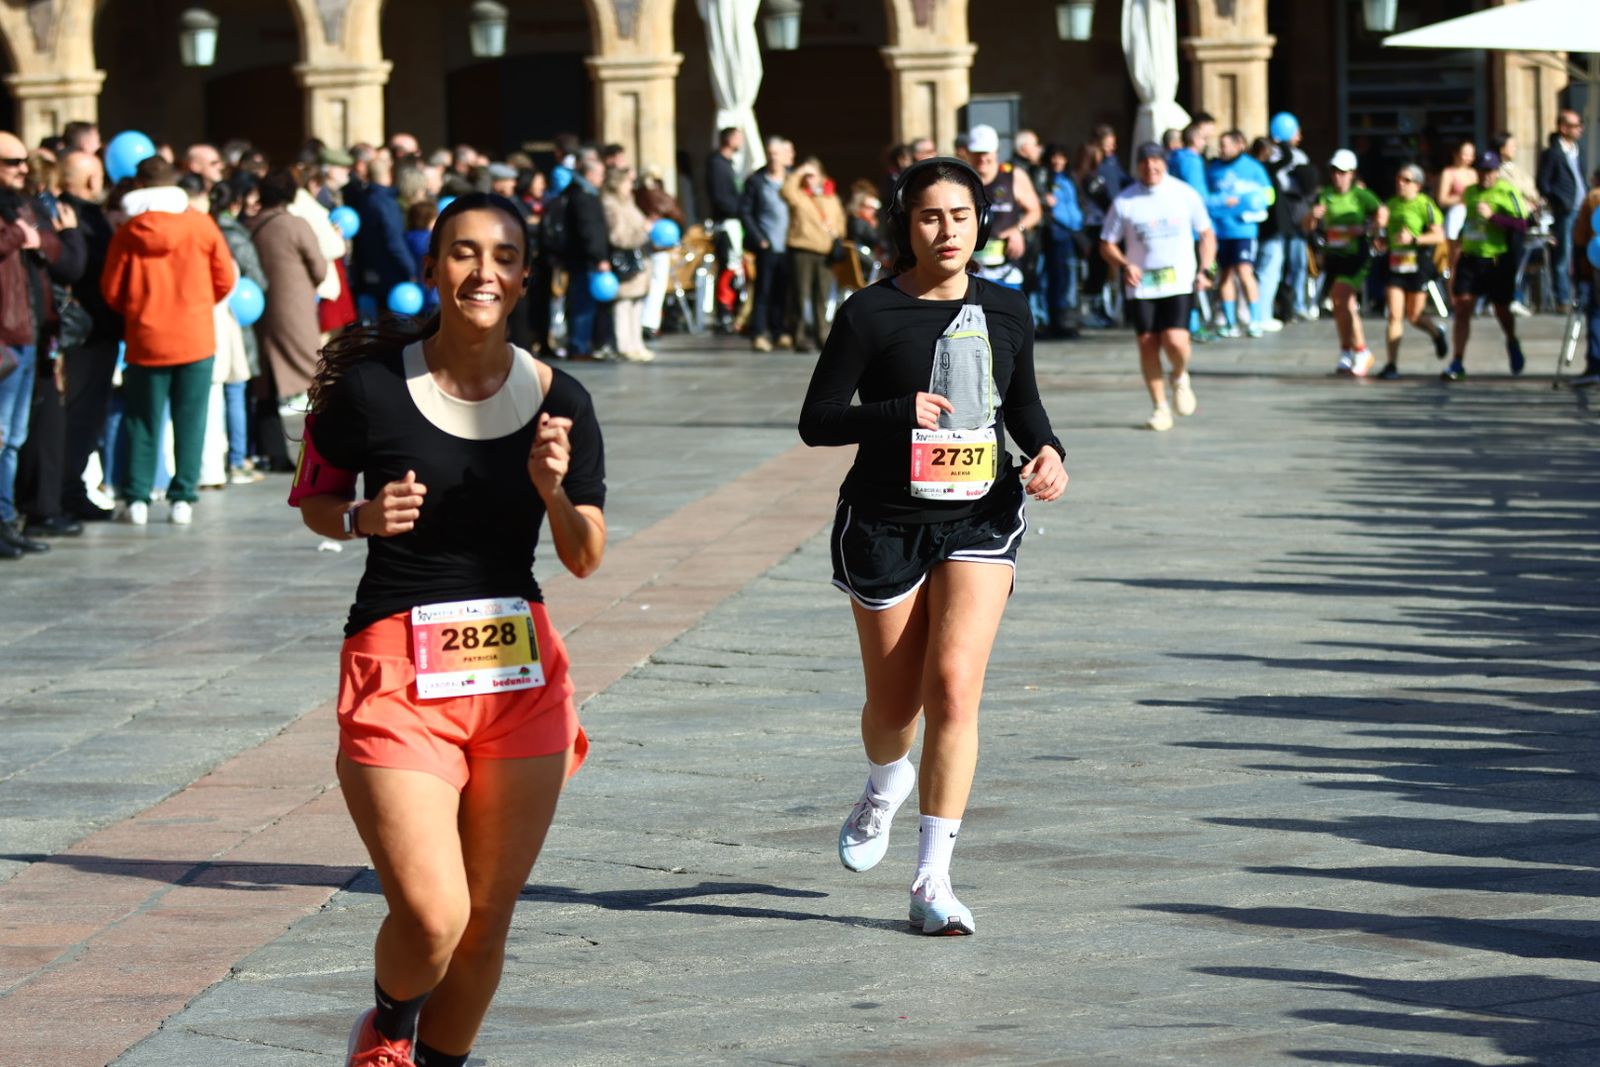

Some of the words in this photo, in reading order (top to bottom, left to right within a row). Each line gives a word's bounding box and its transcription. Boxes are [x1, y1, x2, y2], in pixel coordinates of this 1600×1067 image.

[931, 448, 985, 466] 2737
[441, 622, 517, 651] 2828
[463, 654, 499, 662] PATRICIA
